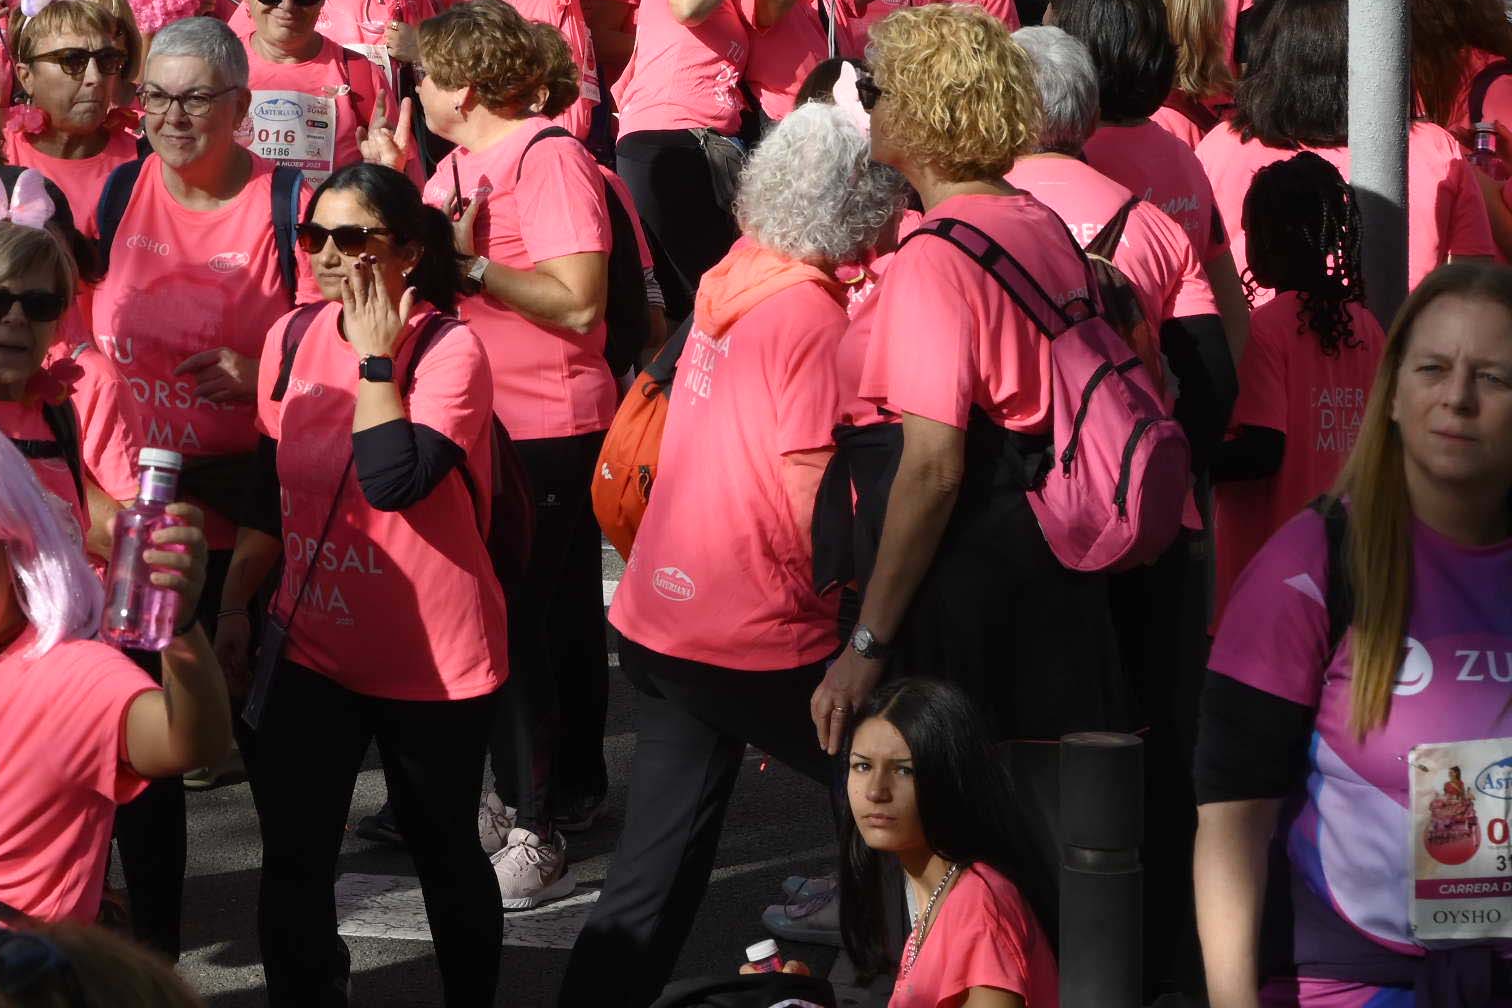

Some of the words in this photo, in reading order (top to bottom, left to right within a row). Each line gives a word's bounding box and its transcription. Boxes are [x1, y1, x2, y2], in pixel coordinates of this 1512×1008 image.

[258, 129, 296, 143] 016
[261, 147, 290, 157] 19186
[99, 335, 134, 364] TU
[128, 377, 235, 410] ORS
[289, 375, 324, 397] YSHO
[140, 414, 201, 449] MA
[287, 532, 383, 574] ORSAL
[286, 570, 350, 614] UMA
[1439, 883, 1497, 896] CARRERA
[1433, 909, 1501, 925] OYSHO
